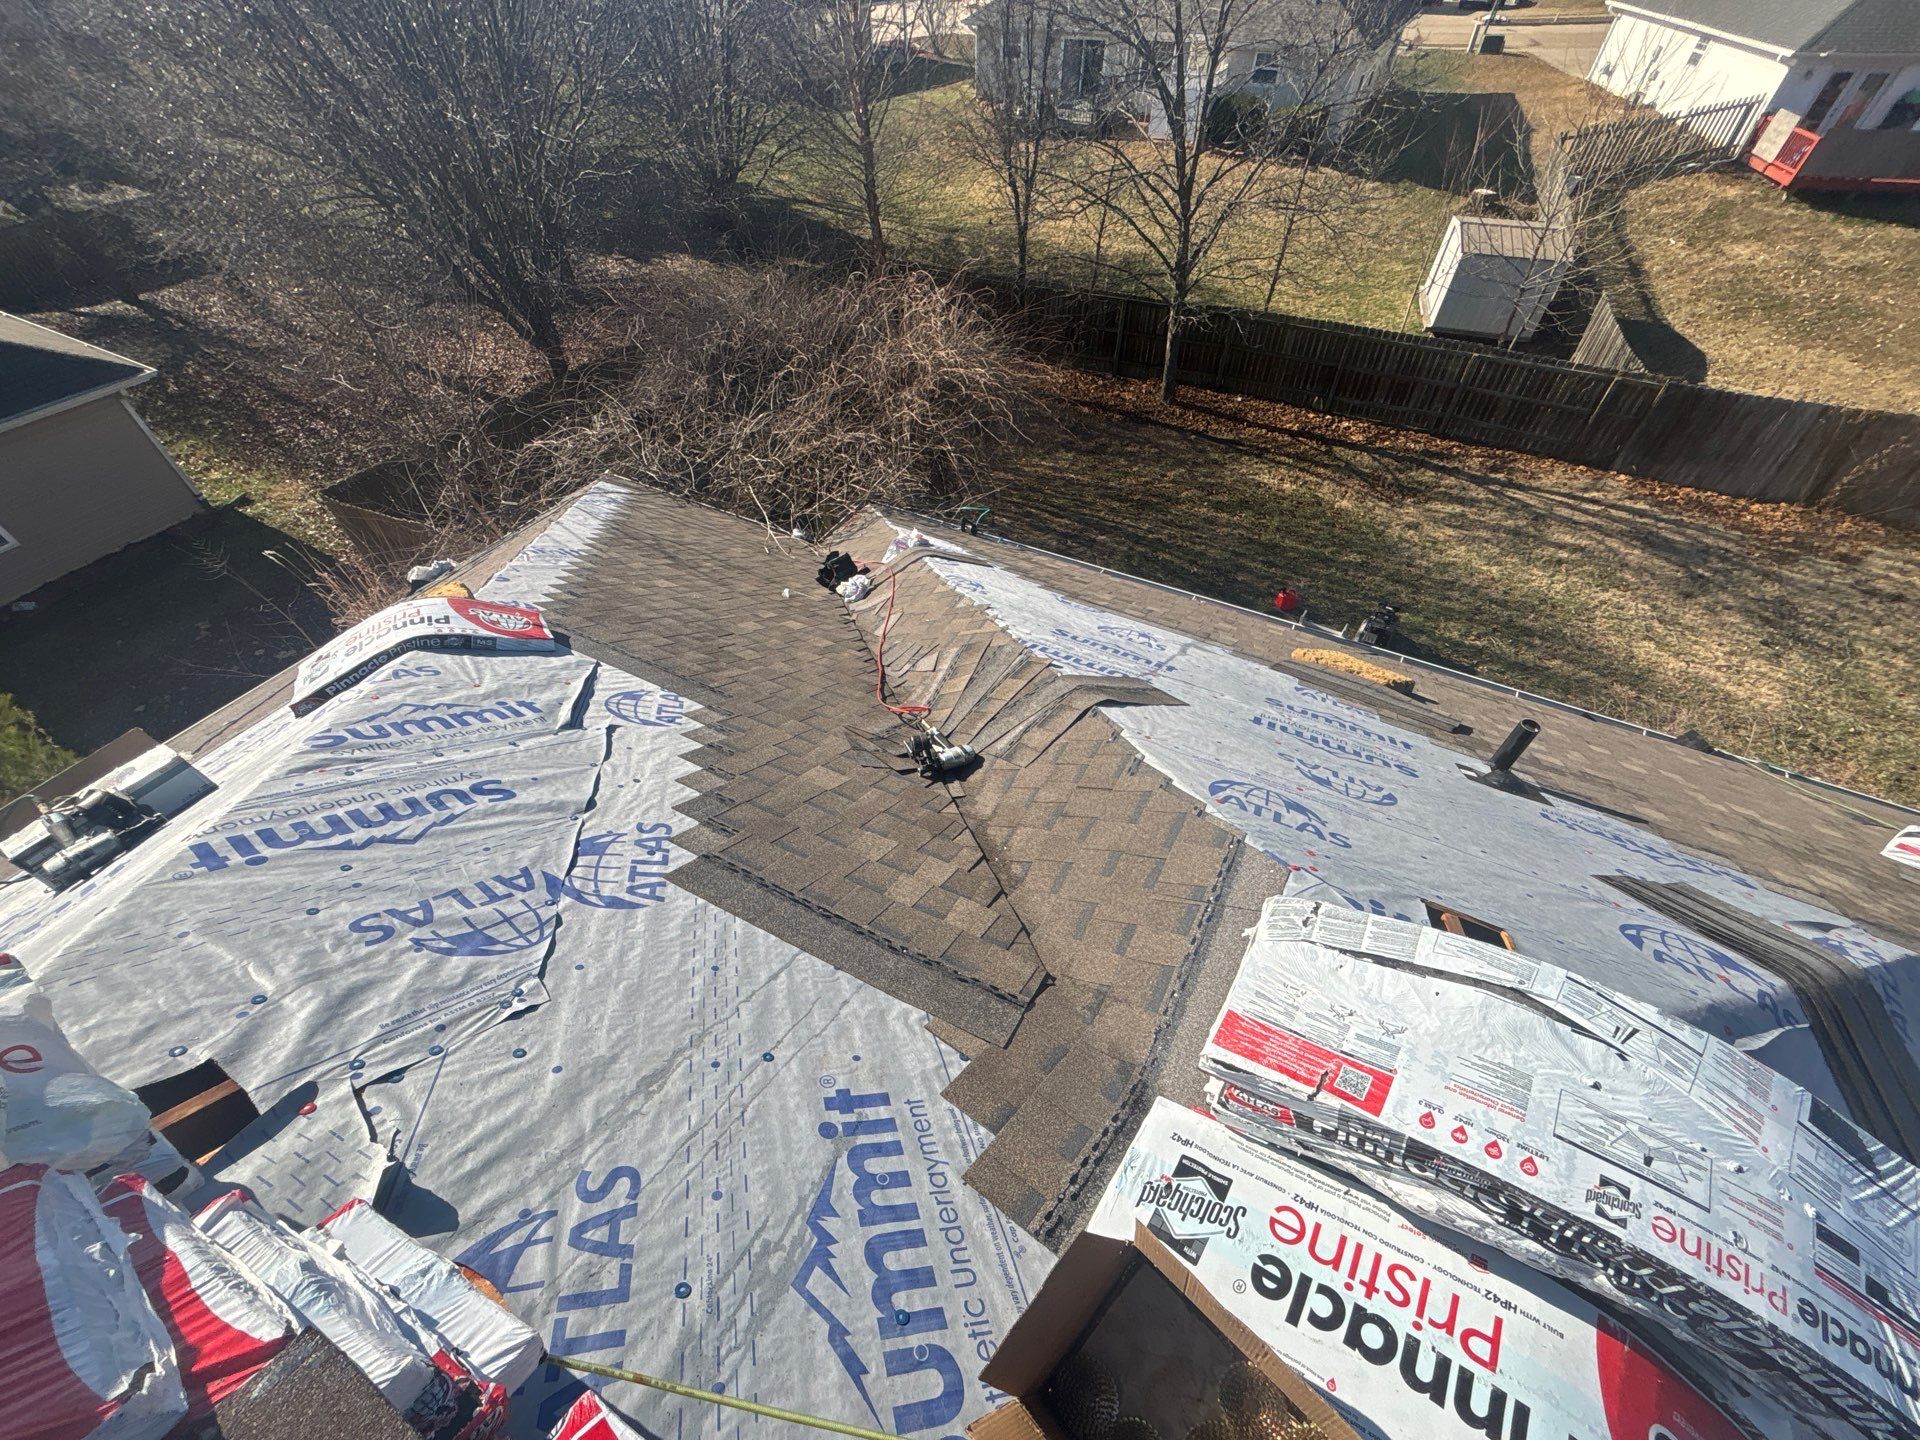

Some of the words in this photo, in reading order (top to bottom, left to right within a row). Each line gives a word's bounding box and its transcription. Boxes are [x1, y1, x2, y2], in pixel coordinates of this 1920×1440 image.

[344, 615, 451, 658] Pinnacle
[1050, 627, 1179, 674] Summit
[1106, 629, 1167, 652] ATLAS
[324, 653, 389, 696] Pinnacle
[389, 636, 442, 658] Pristine
[304, 699, 545, 750] Summit
[330, 733, 425, 757] Synthetic
[427, 716, 548, 745] Underlayment
[1265, 696, 1414, 750] Summit
[1249, 716, 1420, 778] Summit
[386, 769, 483, 797] Synthetic
[1277, 752, 1385, 793] ATLAS
[1215, 794, 1352, 849] ATLAS
[625, 820, 673, 902] ATLAS
[348, 865, 538, 947] ATLAS
[382, 1020, 429, 1045] Conforms
[1194, 1144, 1232, 1168] TECHNOLOGIE
[1231, 1163, 1240, 1171] LA
[1516, 1142, 1550, 1162] LIFETIME
[1181, 1158, 1209, 1178] PROTECTOR
[1208, 1171, 1230, 1187] SHINGLE
[1238, 1168, 1255, 1180] AVEC
[905, 1098, 980, 1291] Underlayment
[1254, 1174, 1287, 1195] CONSTRUIT
[1324, 1186, 1337, 1197] part
[1134, 1180, 1248, 1240] Scotchgard
[1585, 1188, 1643, 1219] Scotchgard
[993, 1242, 1002, 1251] on
[1362, 1228, 1379, 1240] CON
[1183, 1245, 1198, 1260] WITH
[1378, 1237, 1425, 1264] CONSTRUIDO
[1651, 1215, 1788, 1316] Pristine
[997, 1250, 1015, 1290] dependent
[1431, 1263, 1482, 1296] TECHNOLOGY
[537, 1164, 642, 1432] ATLAS
[1010, 1290, 1021, 1306] vary
[1268, 1205, 1505, 1375] Pristine
[1519, 1308, 1541, 1325] WITH
[1542, 1323, 1565, 1340] BUILT
